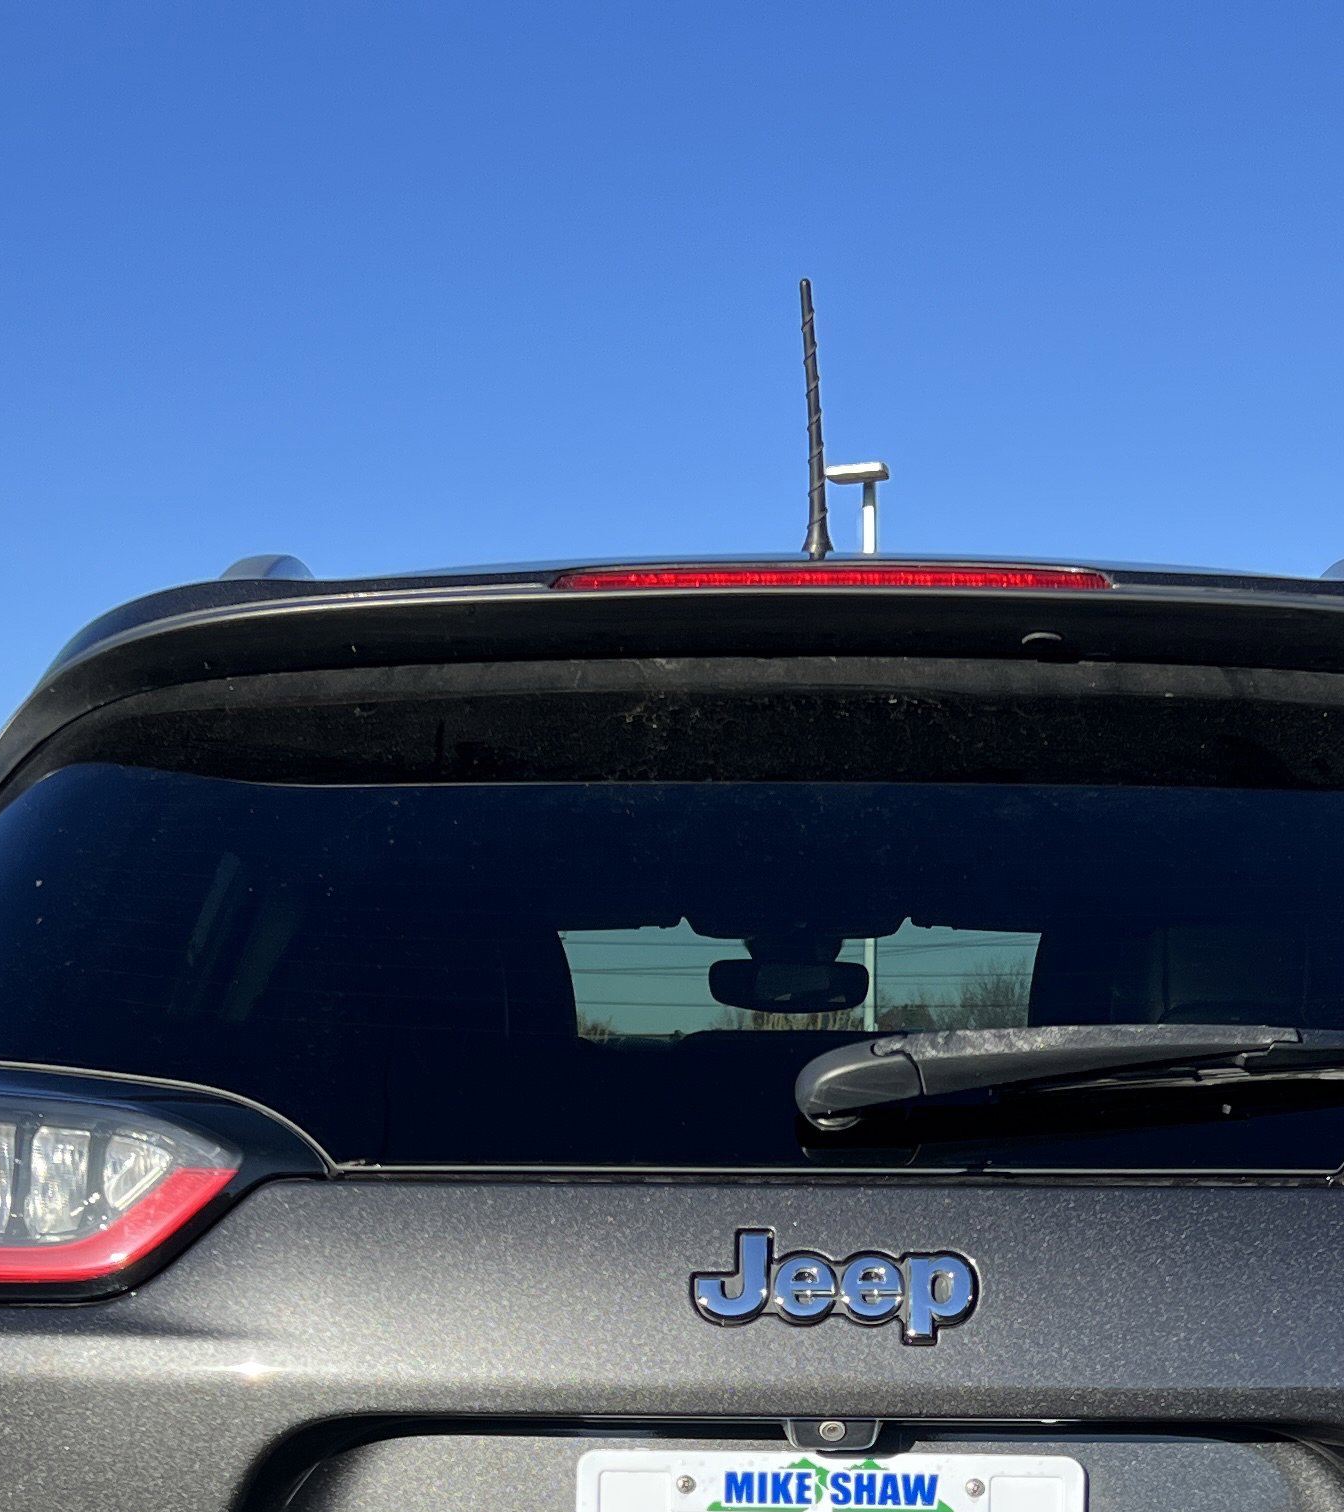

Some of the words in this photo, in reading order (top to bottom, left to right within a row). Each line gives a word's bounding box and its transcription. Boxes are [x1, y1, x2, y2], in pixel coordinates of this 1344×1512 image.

[691, 1228, 981, 1345] Jeep
[724, 1470, 813, 1505] MIKE
[829, 1472, 939, 1507] SHAW
